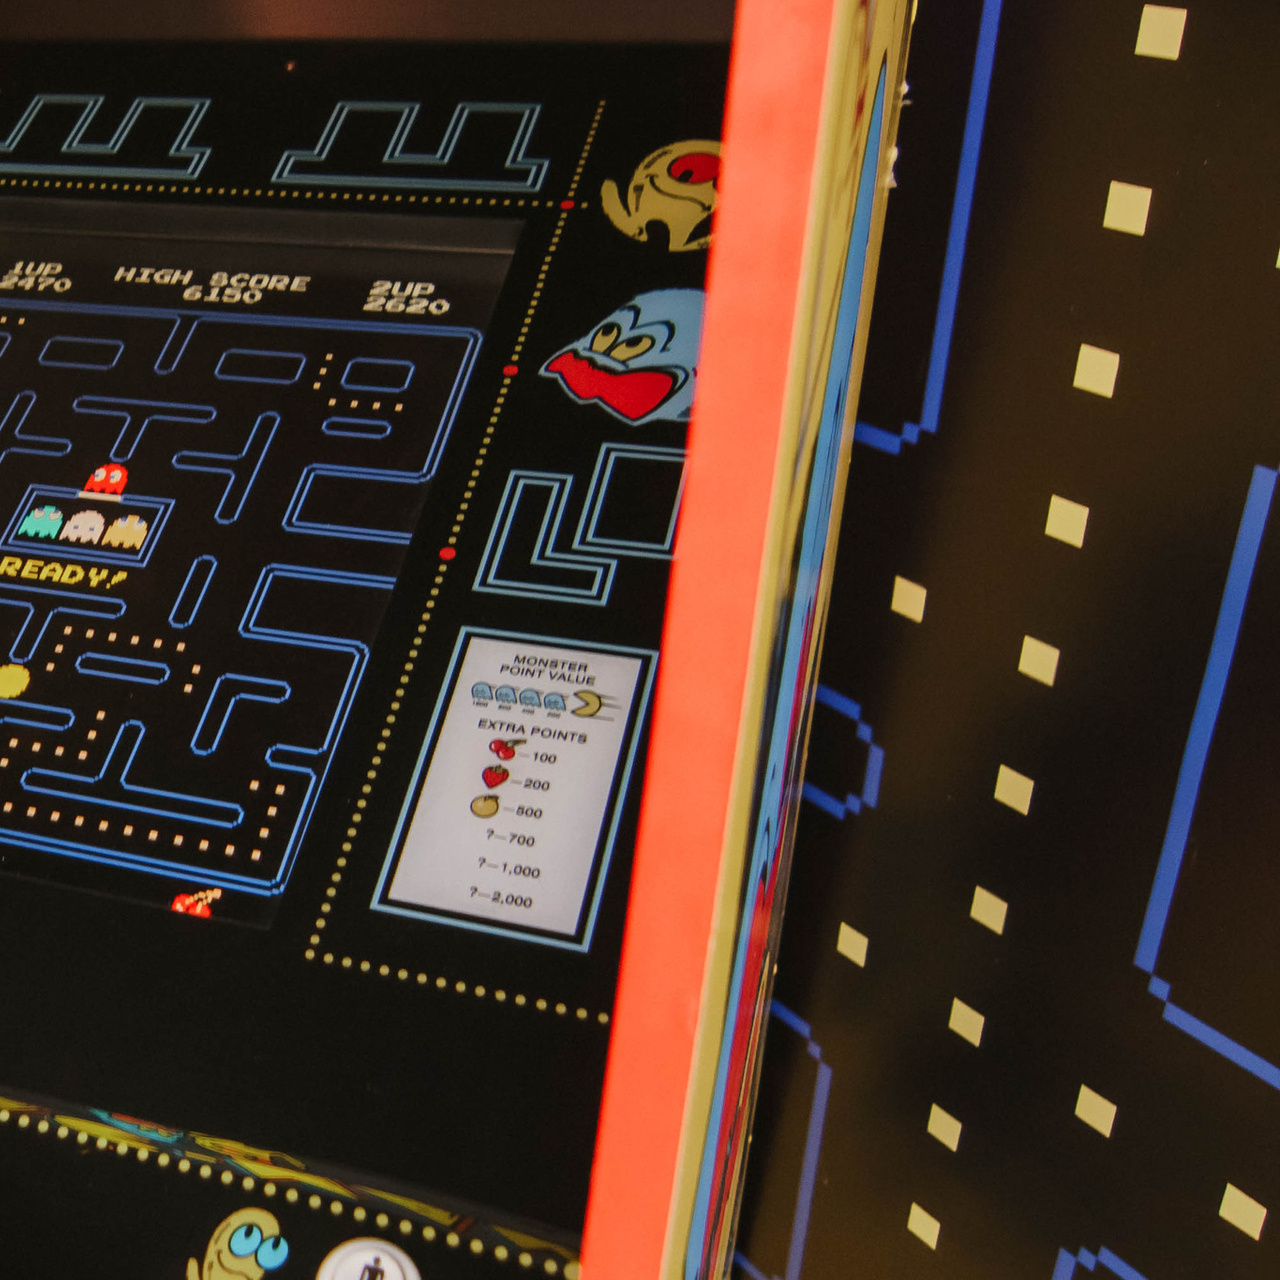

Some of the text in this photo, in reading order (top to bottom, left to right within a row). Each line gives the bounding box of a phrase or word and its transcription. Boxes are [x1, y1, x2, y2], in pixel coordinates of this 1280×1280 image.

[12, 260, 64, 277] 1UP
[114, 266, 312, 292] HIGH SCORE
[182, 284, 263, 305] 6150
[369, 279, 436, 299] 2UP
[362, 295, 451, 316] 2620
[513, 654, 588, 673] MONSTER
[500, 663, 596, 687] POINT VALUE
[478, 718, 588, 744] EXTRA POINTS
